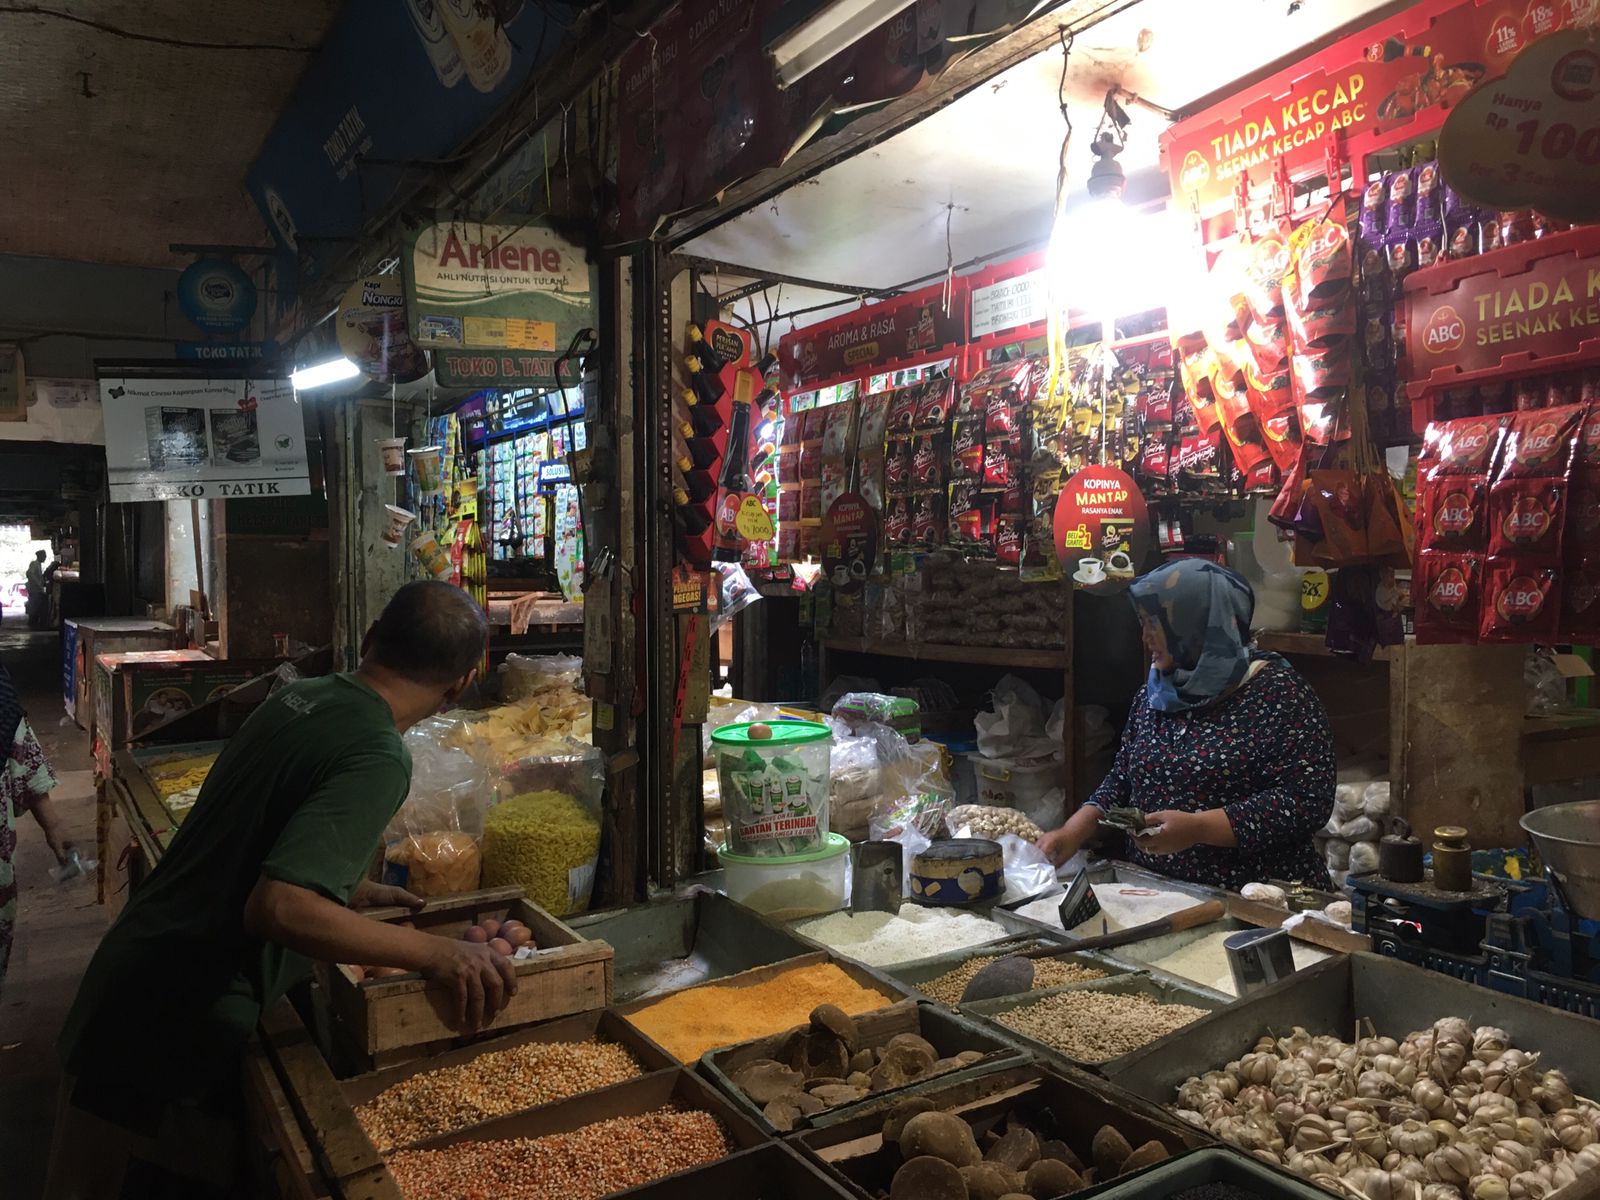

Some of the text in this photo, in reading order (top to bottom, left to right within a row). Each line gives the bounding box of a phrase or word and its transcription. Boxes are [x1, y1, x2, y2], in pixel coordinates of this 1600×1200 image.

[1531, 6, 1553, 25] 18%
[889, 11, 913, 42] ABC
[1496, 25, 1516, 43] 11%
[1491, 93, 1542, 112] Hanya
[1211, 74, 1365, 161] TIADA KECAP
[1486, 112, 1509, 130] Rp
[1215, 104, 1366, 181] SEENAK KECAP ABC
[437, 272, 460, 281] AHLI
[500, 276, 531, 285] UNTUK
[1473, 277, 1575, 321] TIADA
[828, 329, 859, 351] AROMA
[860, 326, 868, 341] &
[869, 317, 896, 339] RASA
[1428, 323, 1461, 345] ABC
[1476, 311, 1562, 346] SEENAK
[195, 346, 263, 360] TOKO TATIK
[848, 346, 874, 361] SPECIAL
[446, 357, 572, 377] TOKO B. TATK
[1456, 435, 1484, 449] ABC
[1524, 434, 1556, 449] ABC
[147, 481, 280, 499] TKO TATIK
[1083, 478, 1121, 490] KOPINYA
[1075, 490, 1128, 506] MANTAP
[721, 508, 738, 523] AB
[833, 511, 865, 525] MANTAP
[1081, 507, 1107, 515] RASANYA
[1440, 507, 1468, 522] ABC
[1510, 512, 1543, 527] ABC
[1067, 524, 1087, 540] BELI 5
[1083, 533, 1091, 549] 1
[1435, 583, 1463, 597] ABC
[1504, 592, 1538, 606] ABC
[774, 815, 817, 831] TERINDAH
